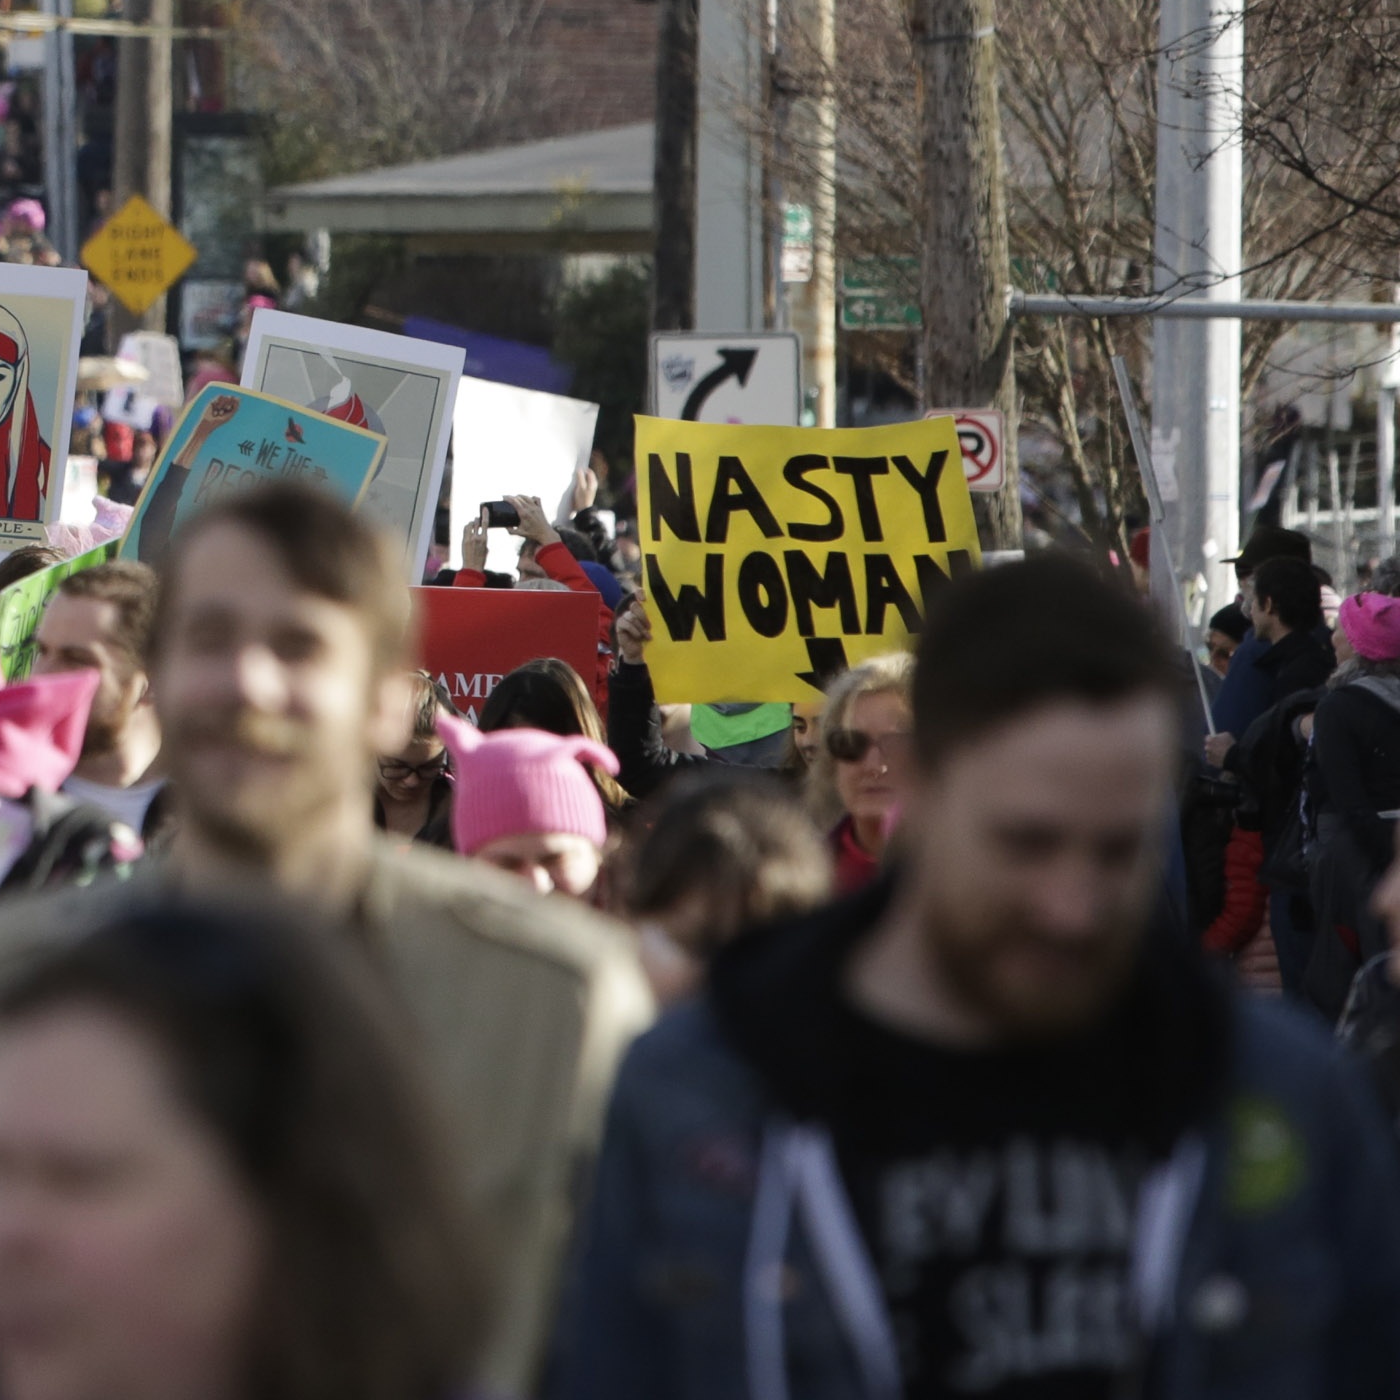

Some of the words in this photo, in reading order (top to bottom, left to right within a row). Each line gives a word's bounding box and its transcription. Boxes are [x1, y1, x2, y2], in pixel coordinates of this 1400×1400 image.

[255, 438, 281, 470] WE
[281, 447, 312, 476] THE
[648, 450, 949, 544] NASTY
